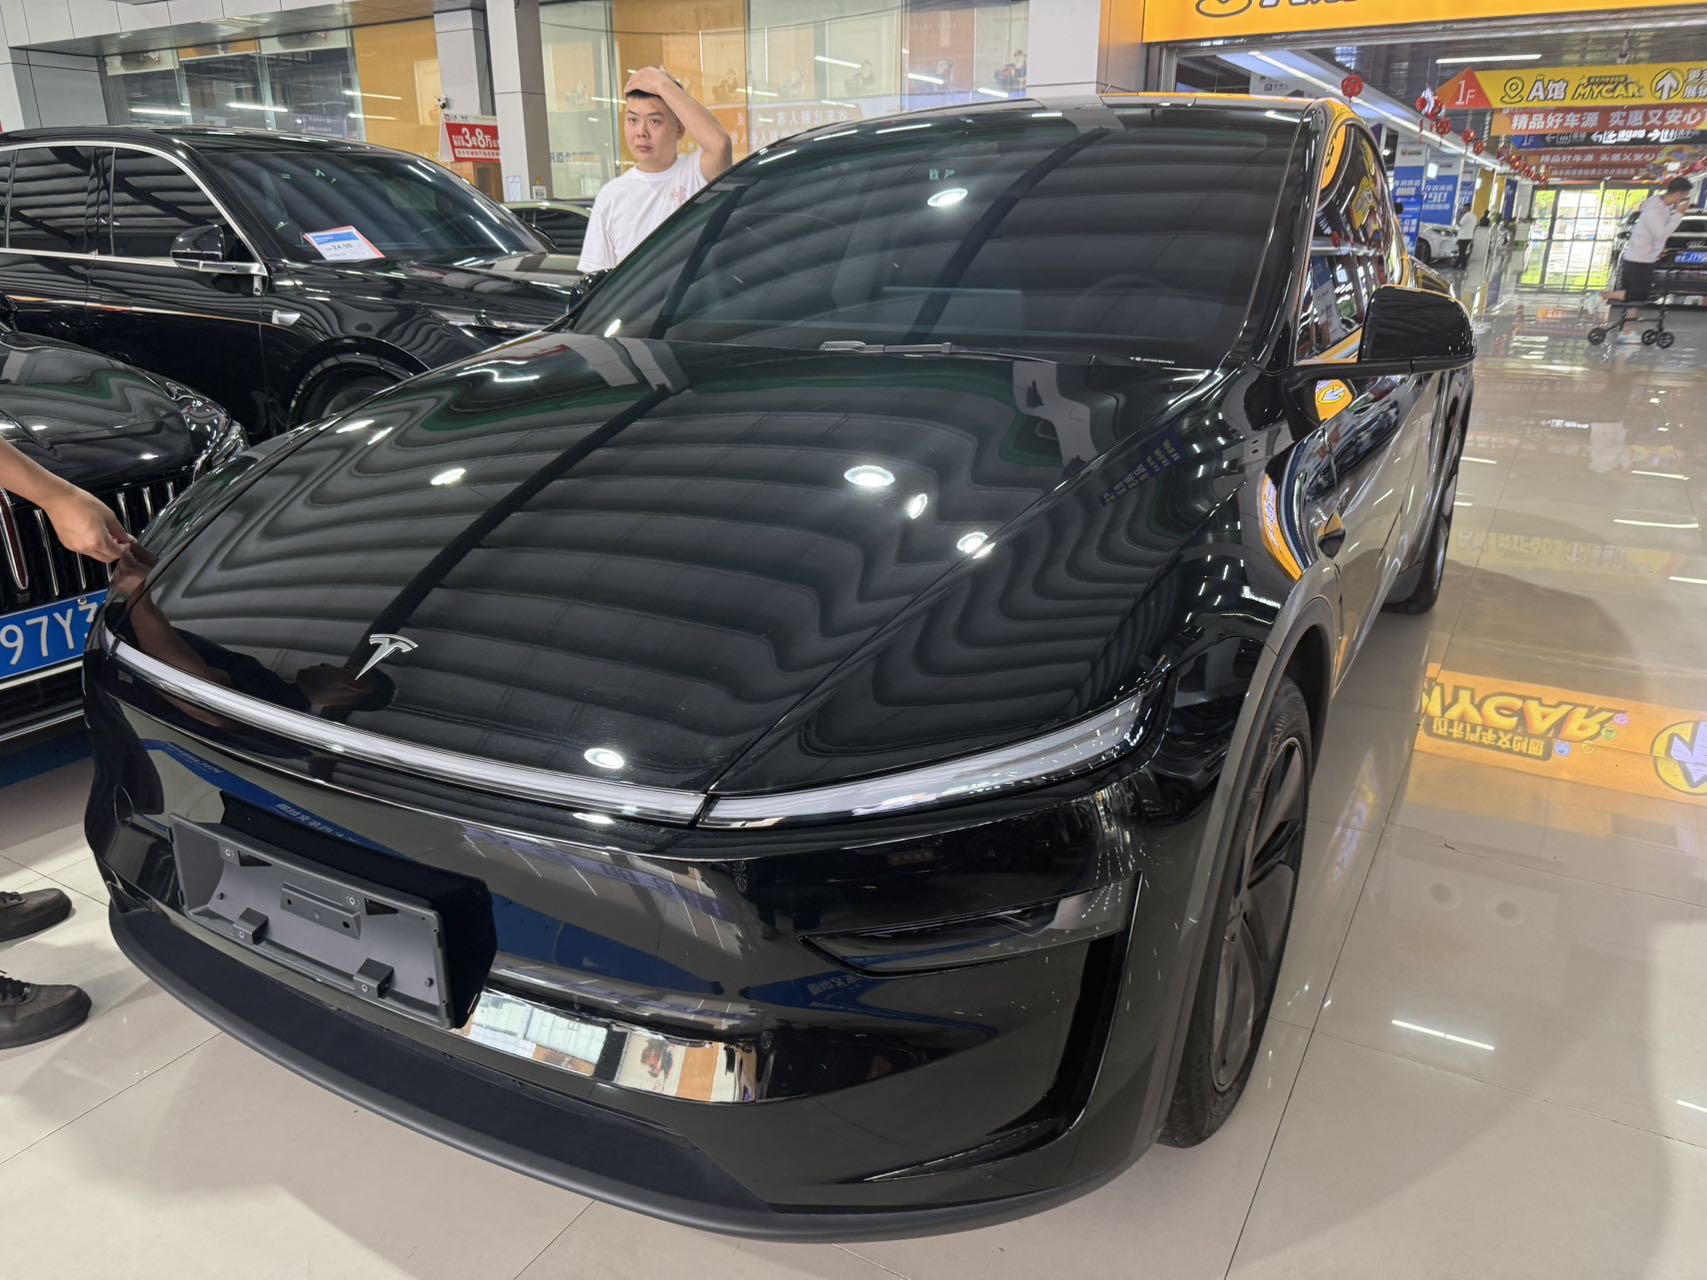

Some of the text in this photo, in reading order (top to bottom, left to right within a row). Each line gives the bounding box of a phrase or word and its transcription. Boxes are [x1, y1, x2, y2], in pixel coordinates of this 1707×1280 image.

[1456, 79, 1476, 106] 1F
[1572, 82, 1642, 100] MYCAR
[1511, 107, 1701, 130] 精品好车源 实惠又安心
